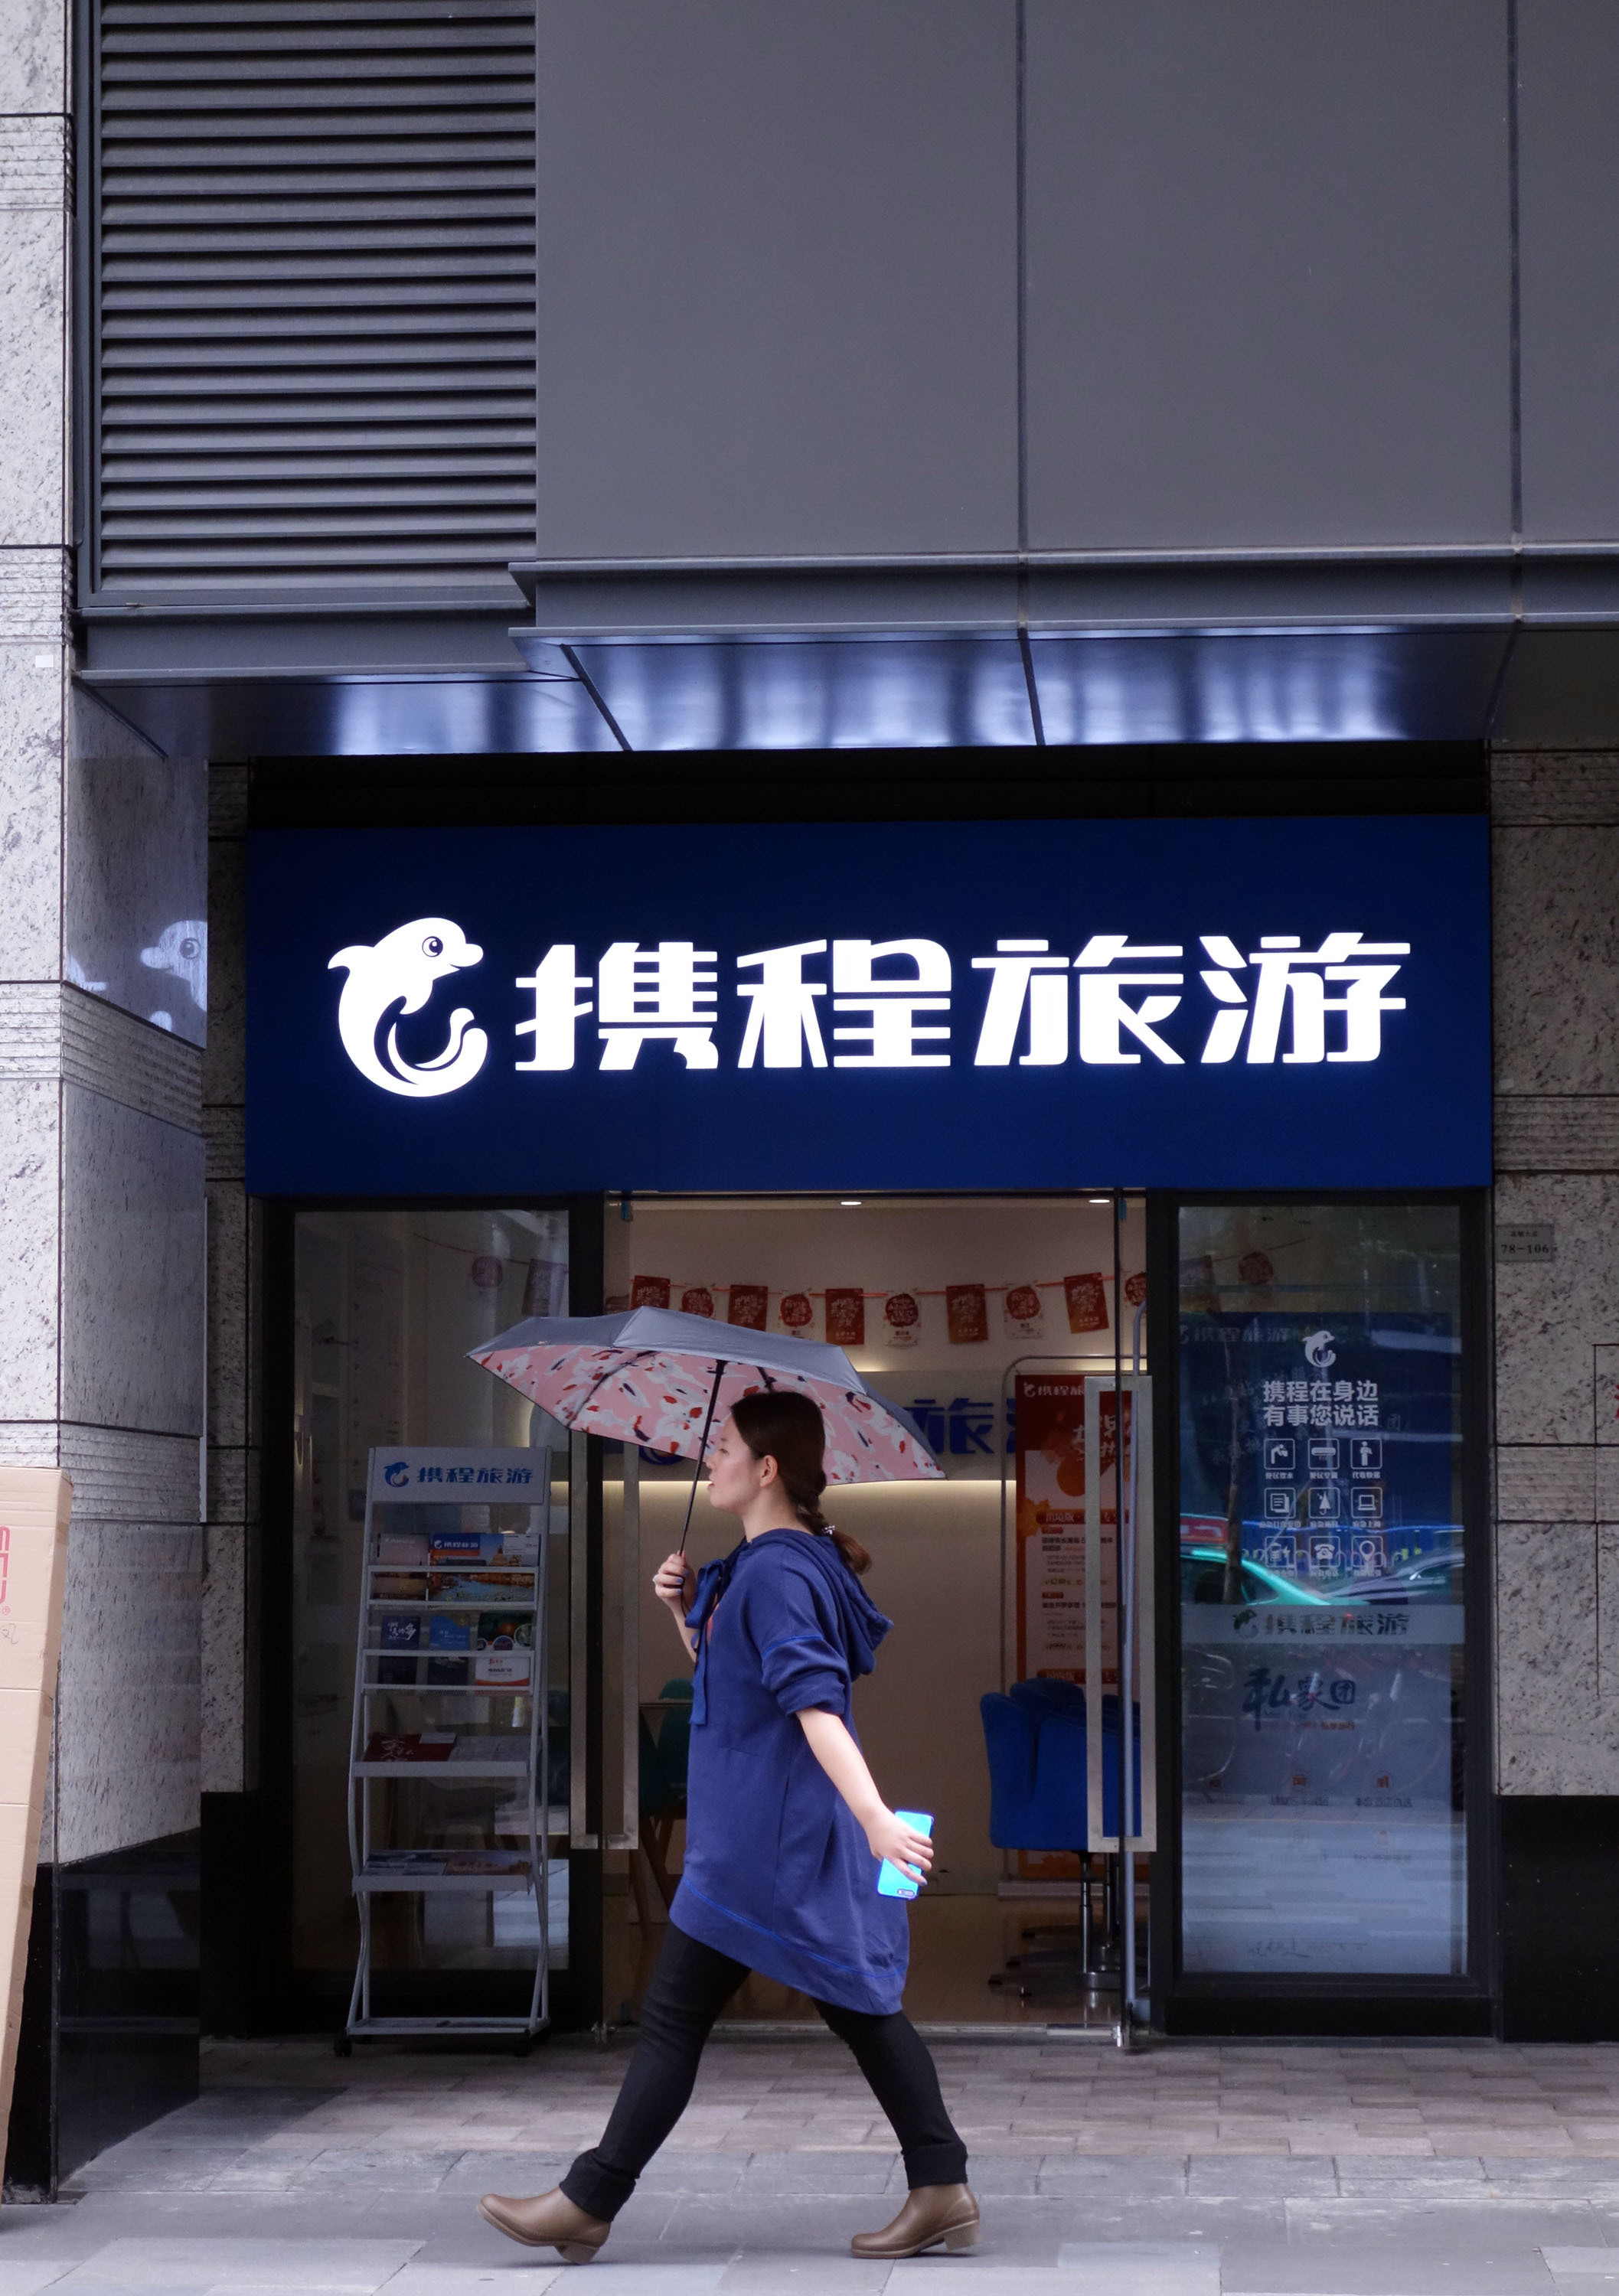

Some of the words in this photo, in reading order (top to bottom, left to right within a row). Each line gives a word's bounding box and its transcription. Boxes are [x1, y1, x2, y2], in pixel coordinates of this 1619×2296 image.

[516, 931, 1410, 1070] 携程旅游
[1501, 1244, 1549, 1254] 78-106
[1037, 1385, 1085, 1397] 携程旅
[1262, 1380, 1378, 1402] 携程在身边
[1263, 1404, 1379, 1427] 有事您说话
[416, 1467, 534, 1485] 携程旅游
[1264, 1613, 1410, 1636] 携程旅游
